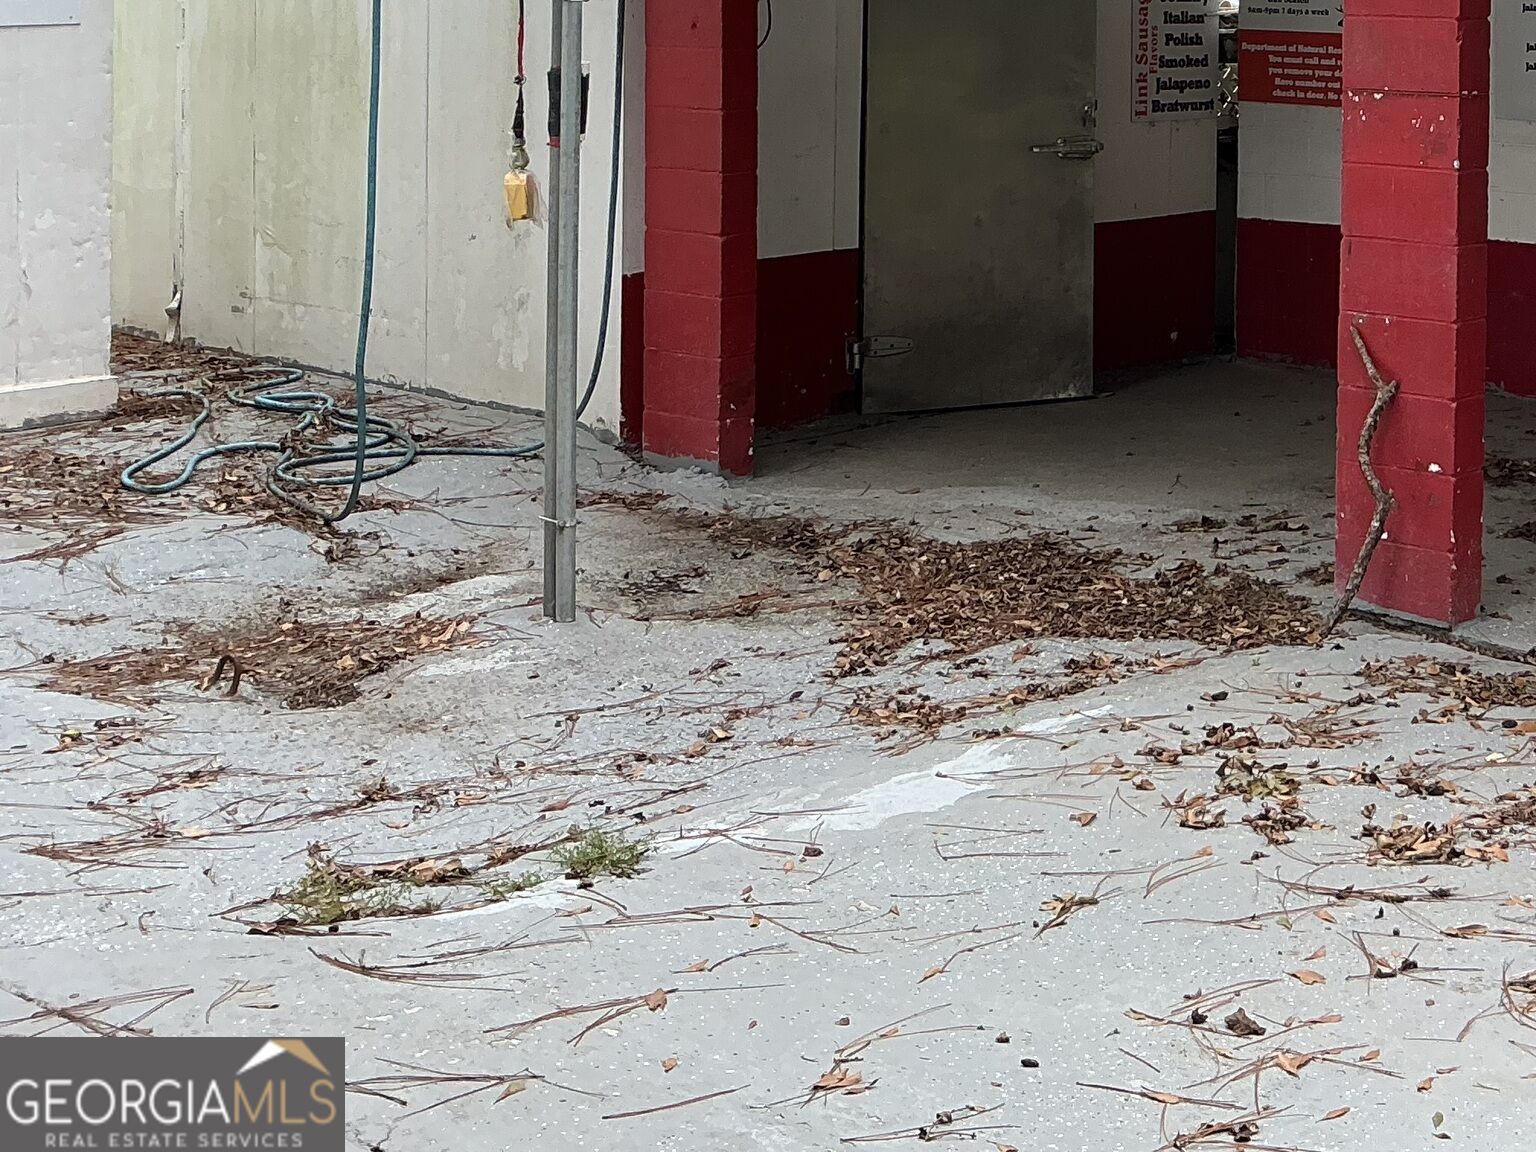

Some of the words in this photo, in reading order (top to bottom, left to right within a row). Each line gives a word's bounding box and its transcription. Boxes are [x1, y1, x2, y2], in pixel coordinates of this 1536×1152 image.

[1163, 10, 1205, 24] Italian
[1164, 33, 1203, 46] Polish
[1149, 25, 1159, 74] Flavors
[1159, 54, 1208, 68] Smoked
[1156, 77, 1210, 95] Jalapeno
[1134, 72, 1148, 117] Link
[1152, 98, 1214, 113] Bratwurst
